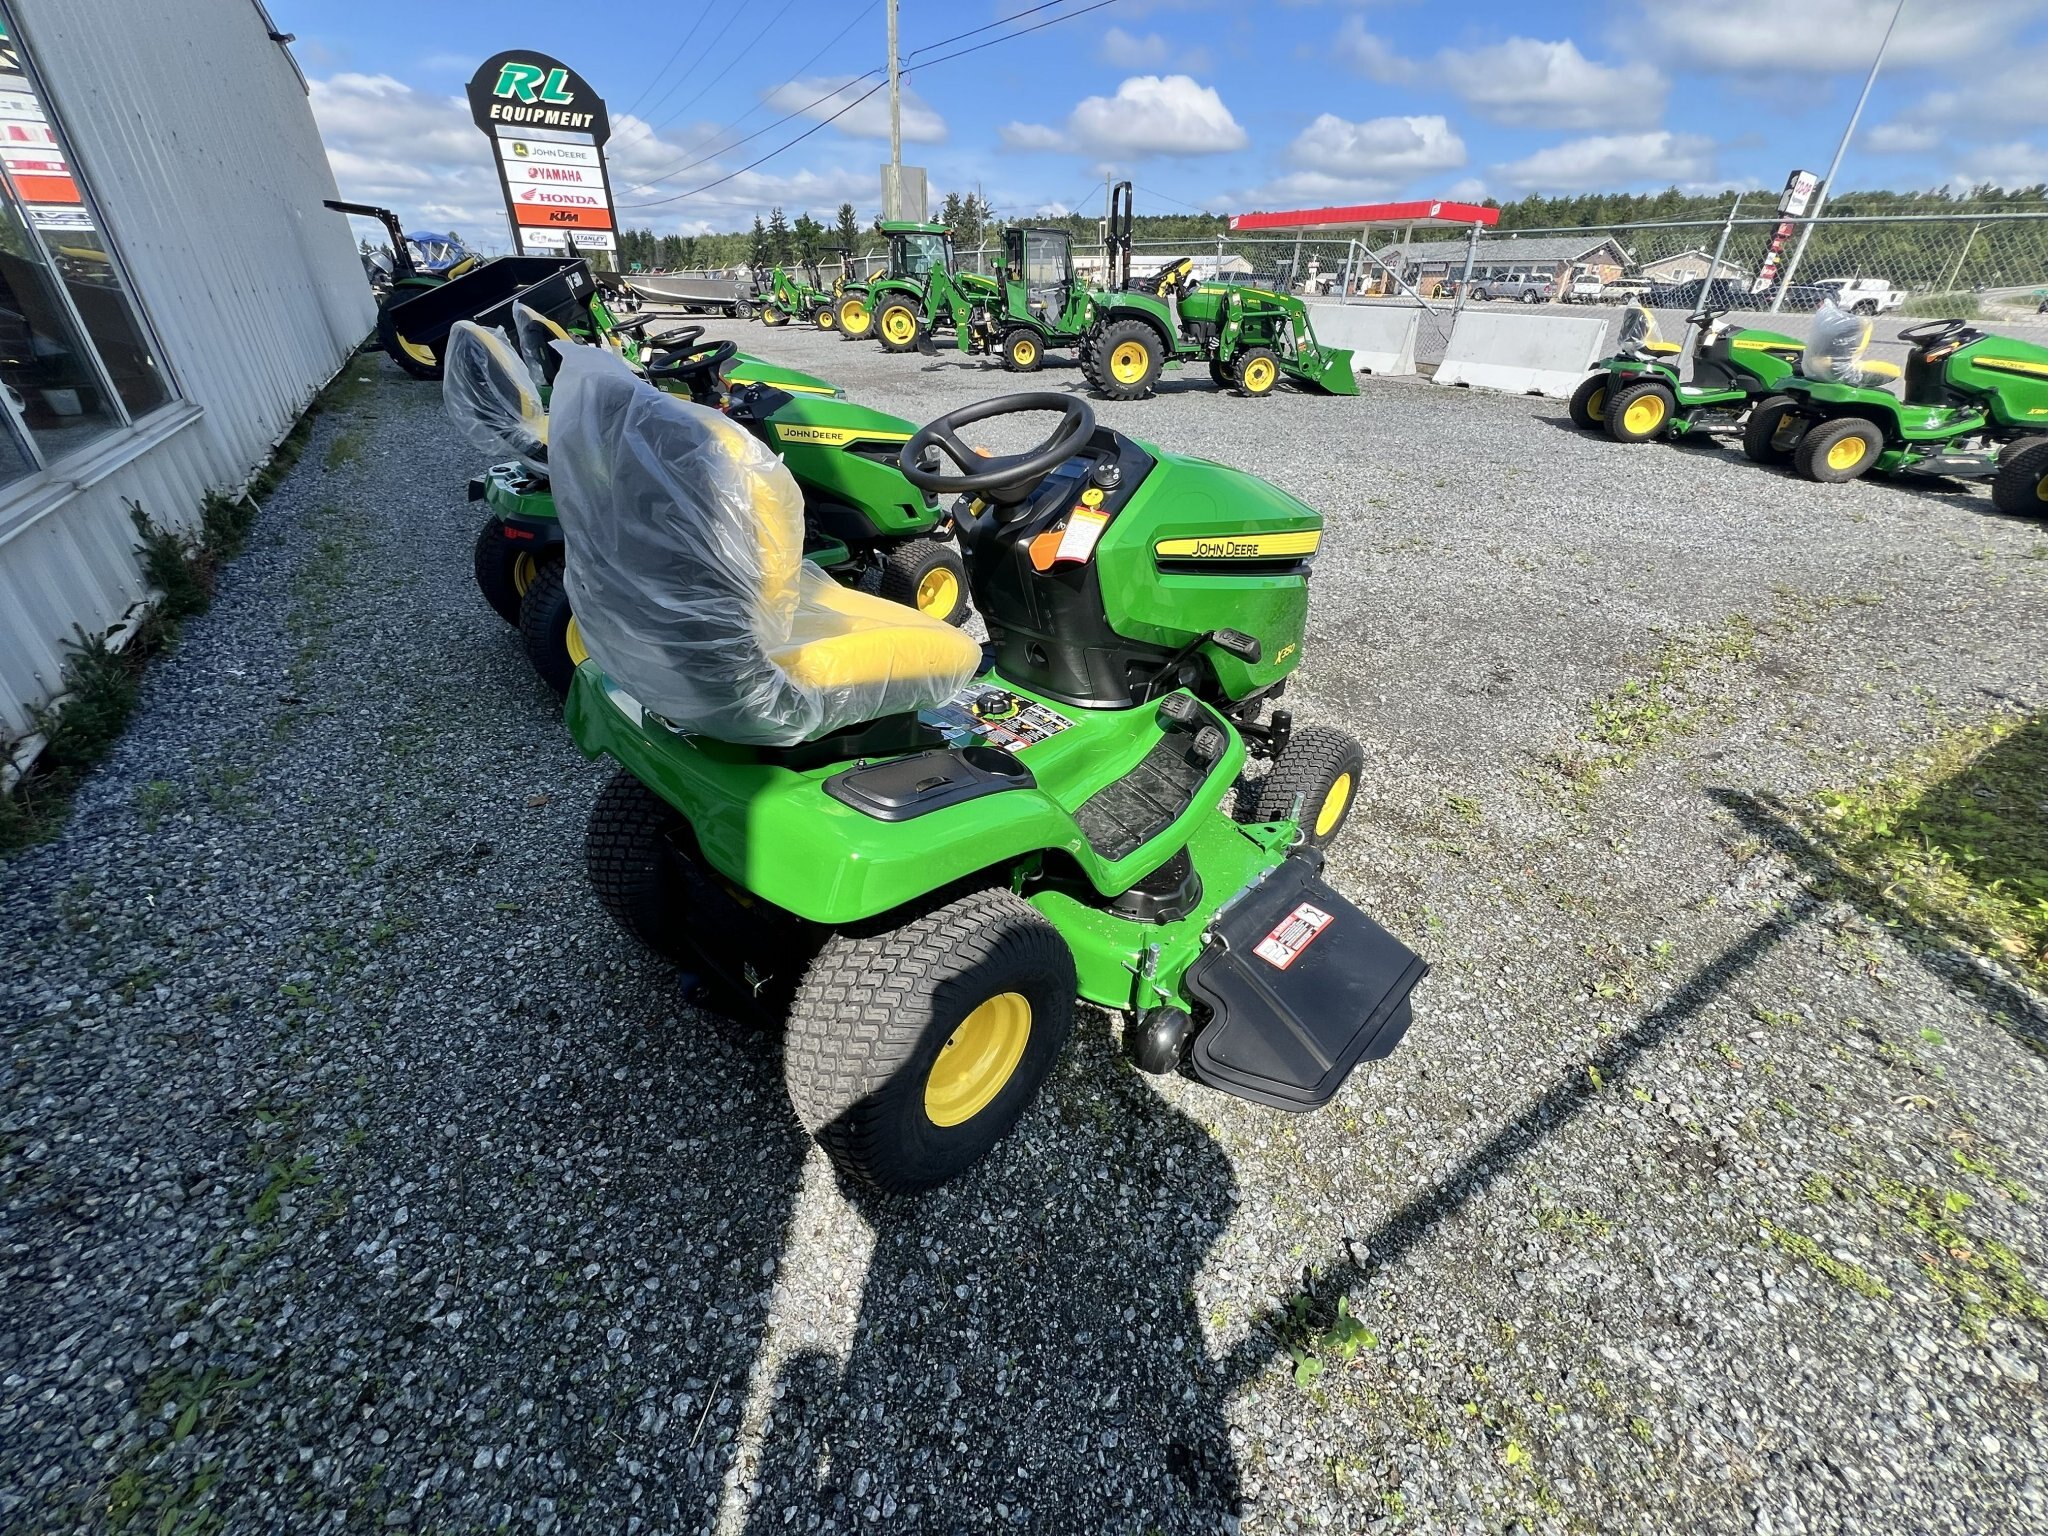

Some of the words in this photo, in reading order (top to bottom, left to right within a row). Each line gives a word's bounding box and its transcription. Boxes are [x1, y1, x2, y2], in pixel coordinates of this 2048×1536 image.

[493, 62, 574, 105] RL
[490, 104, 594, 128] EQUIPMENT
[532, 147, 556, 157] JOHN
[557, 149, 587, 159] DEERE
[538, 167, 583, 182] YAMAHA
[539, 193, 599, 205] HONDA
[550, 210, 579, 222] KTM
[784, 428, 811, 438] JOHN
[812, 430, 844, 440] DEERE
[1192, 540, 1224, 556] JOHN
[1226, 541, 1259, 556] DEERE
[1273, 642, 1296, 666] X350
